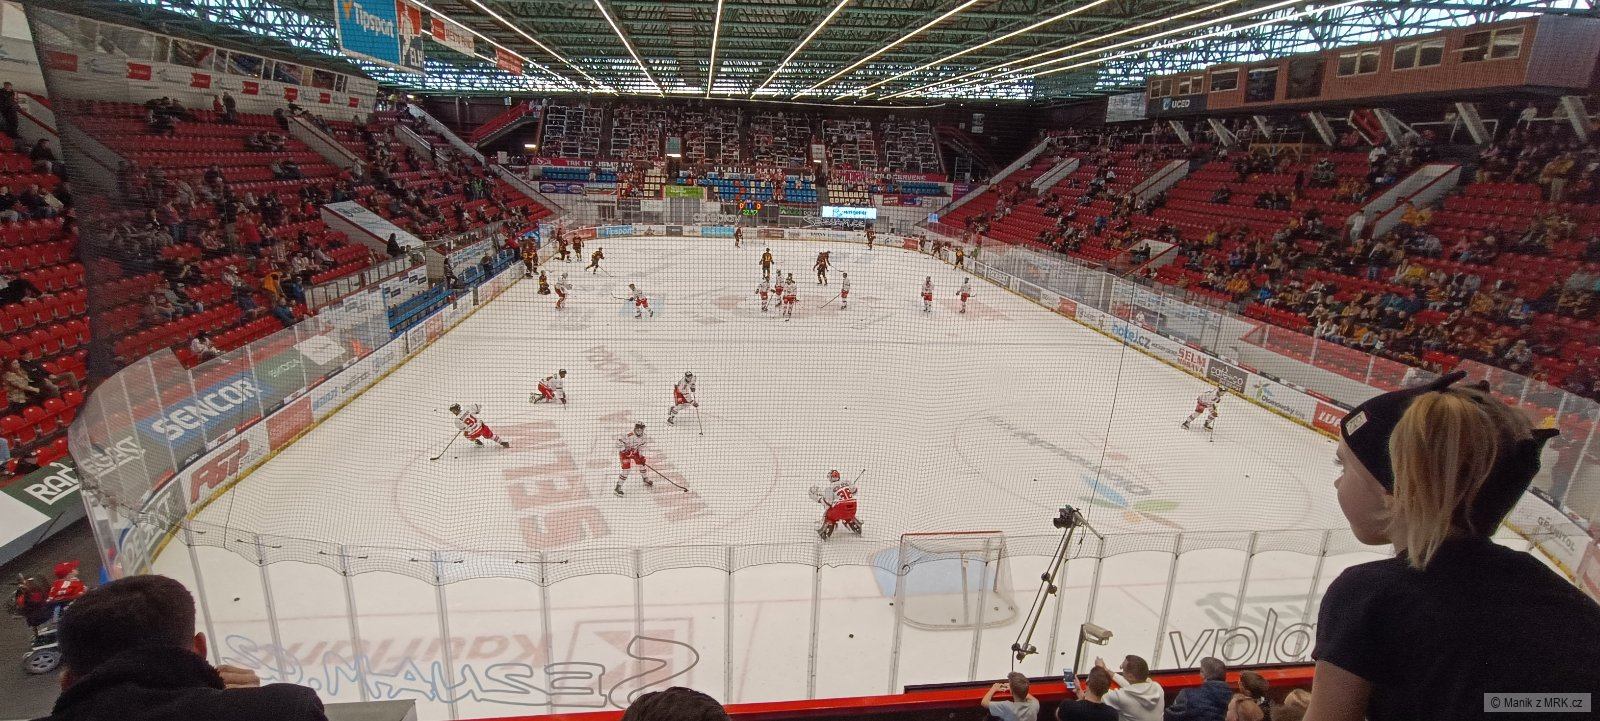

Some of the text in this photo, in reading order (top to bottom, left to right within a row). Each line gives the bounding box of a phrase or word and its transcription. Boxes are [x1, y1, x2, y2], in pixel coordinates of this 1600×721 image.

[353, 2, 395, 38] Tipsport
[1171, 100, 1190, 108] UCED
[152, 376, 264, 442] SENCOR
